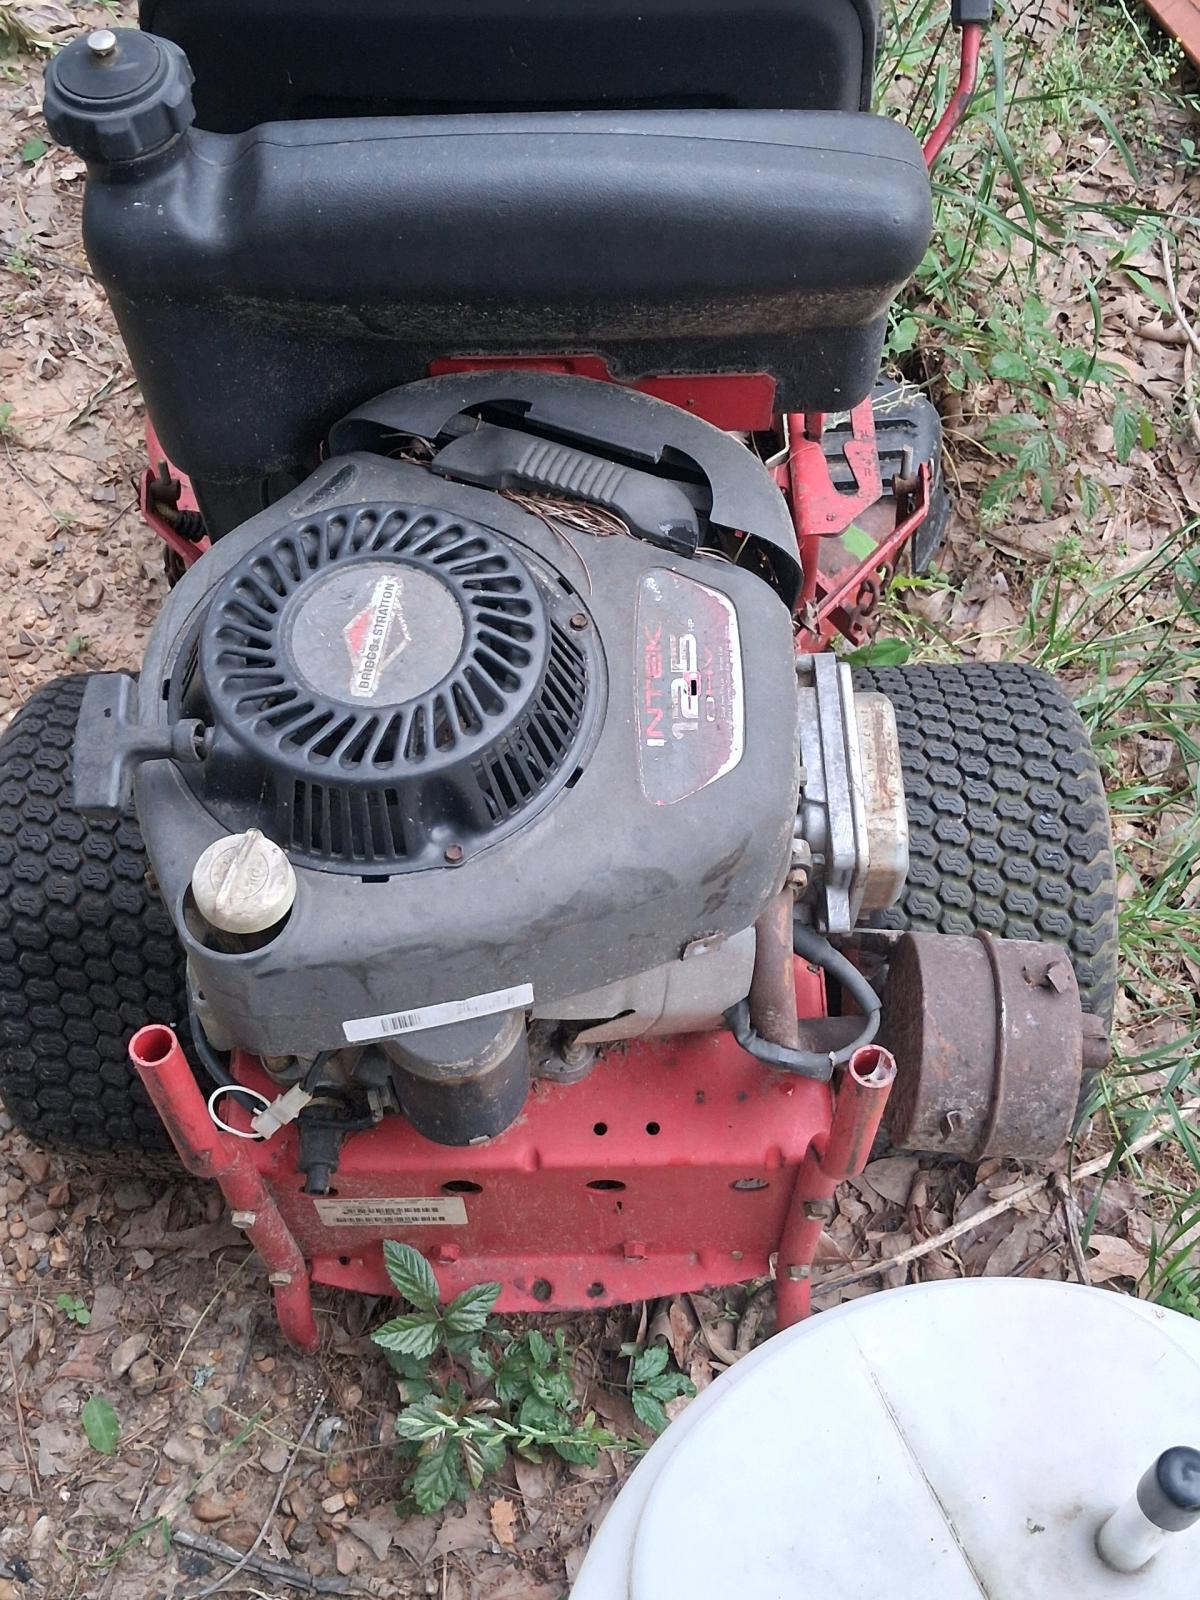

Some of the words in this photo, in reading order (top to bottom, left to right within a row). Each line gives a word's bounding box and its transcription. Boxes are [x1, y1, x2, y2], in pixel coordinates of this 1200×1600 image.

[359, 644, 380, 689] BRIGGS
[373, 583, 394, 636] STRATTON
[644, 622, 665, 746] INTEK
